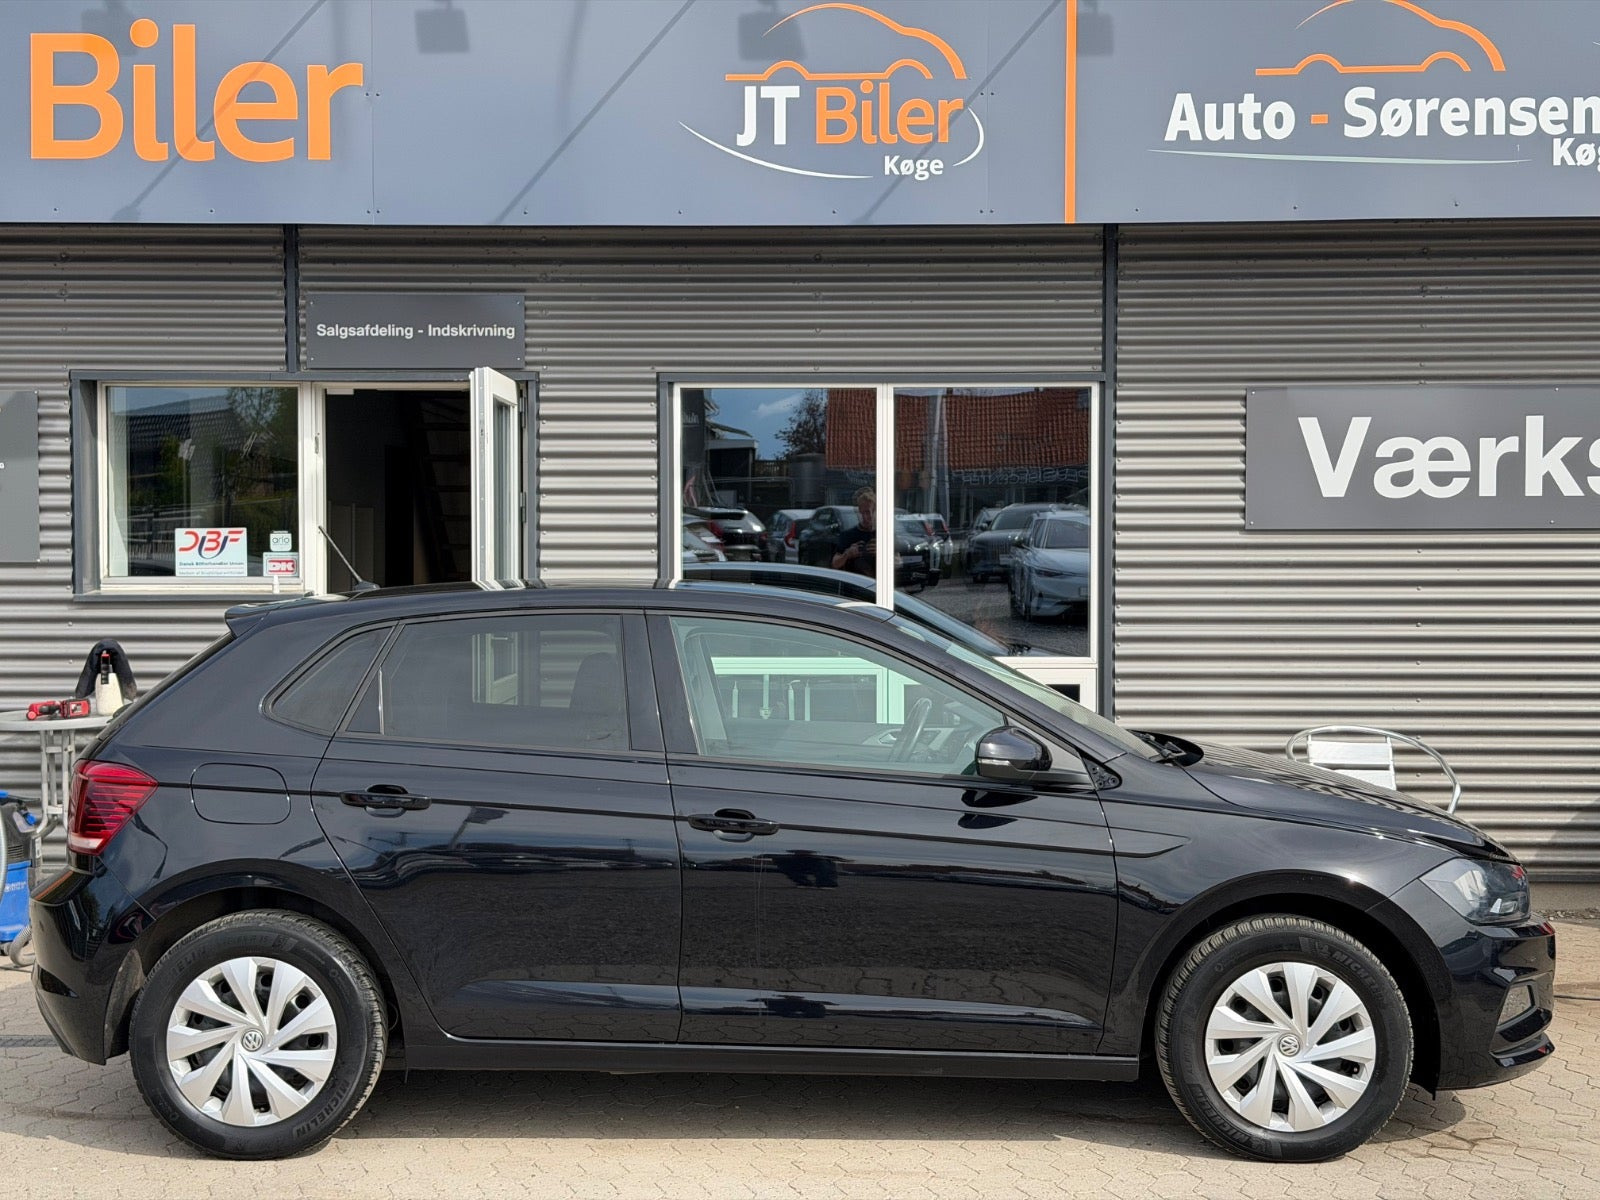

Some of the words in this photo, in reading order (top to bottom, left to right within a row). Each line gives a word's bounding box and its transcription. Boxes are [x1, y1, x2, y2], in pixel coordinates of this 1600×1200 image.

[30, 18, 364, 162] Biler
[736, 85, 800, 147] JT
[815, 80, 964, 145] Biler
[1164, 92, 1296, 142] Auto
[1343, 86, 1600, 138] Sørensen
[883, 155, 944, 181] Køge
[1552, 137, 1600, 173] Kø
[316, 323, 414, 340] Salgsafdeling
[428, 323, 516, 340] Indskrivning
[1297, 415, 1600, 499] Værk
